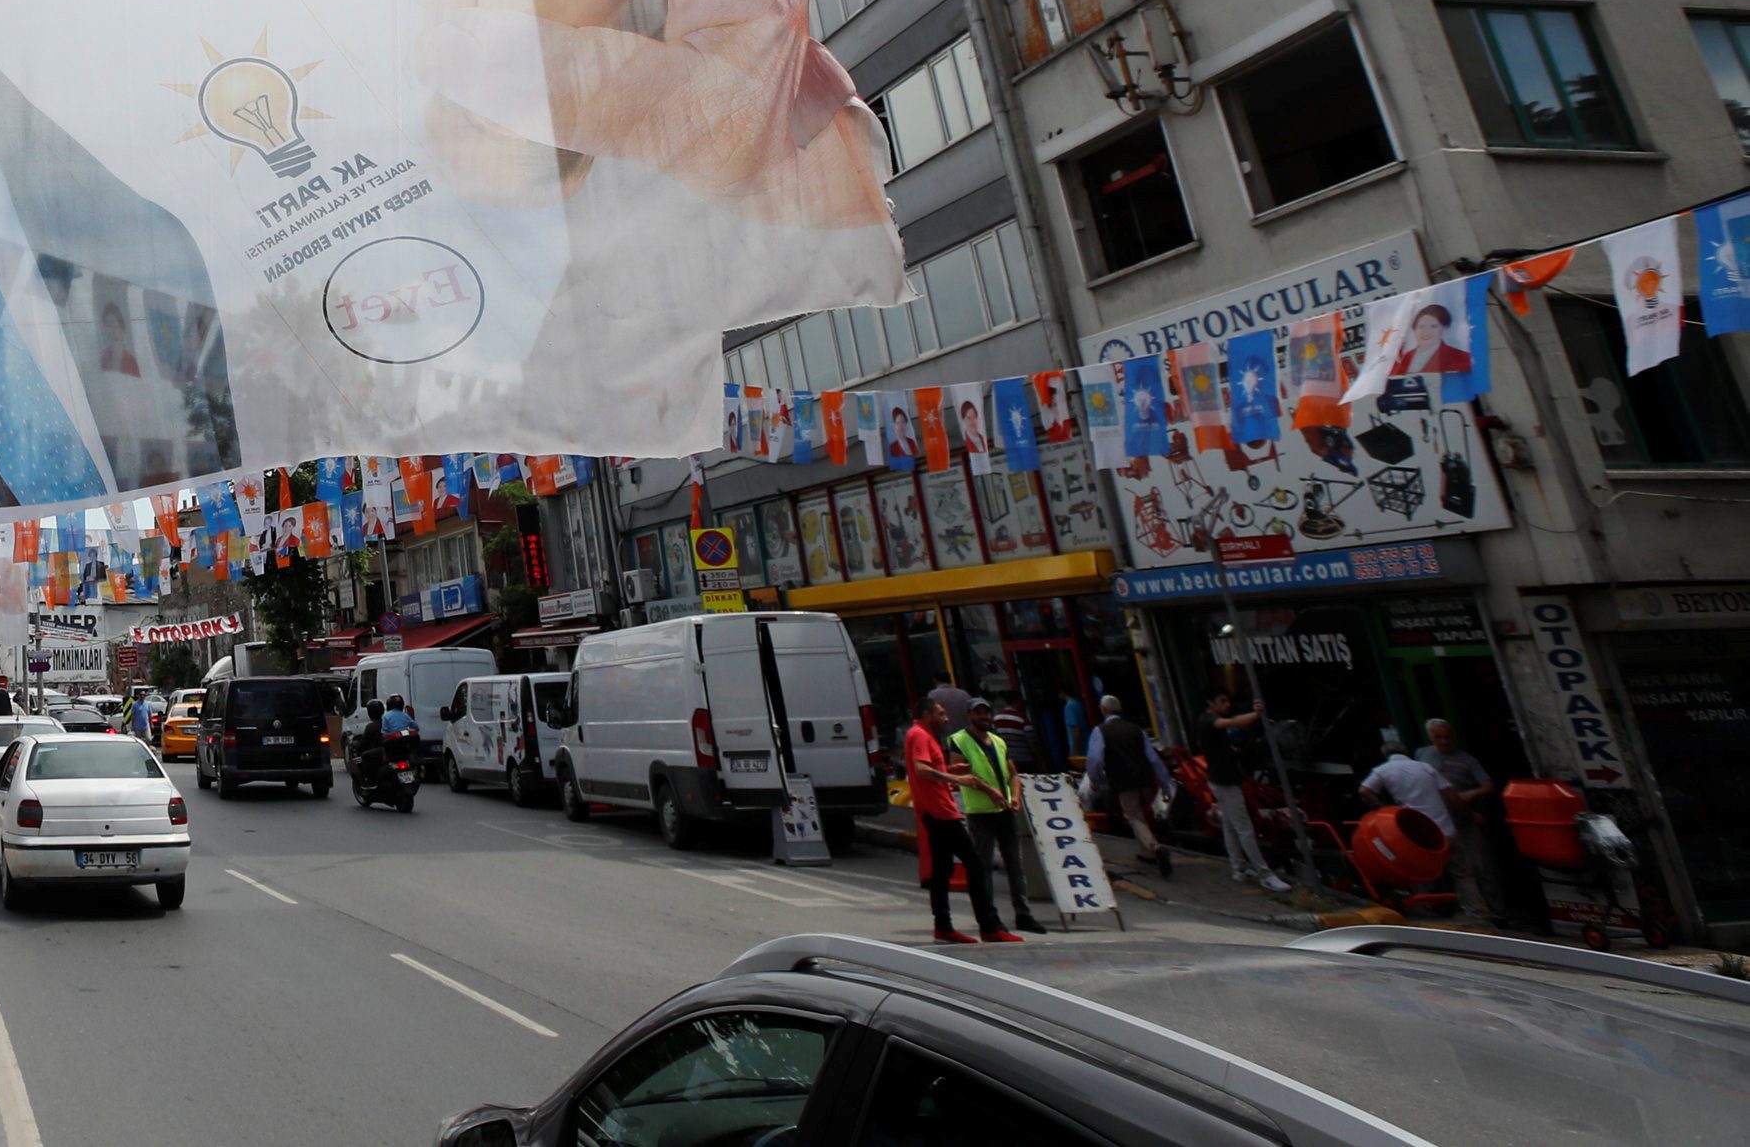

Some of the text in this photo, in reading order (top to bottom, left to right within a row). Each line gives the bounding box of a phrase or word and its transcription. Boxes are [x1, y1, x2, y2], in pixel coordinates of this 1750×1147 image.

[1139, 257, 1392, 354] BETONCULAR
[148, 618, 223, 644] OTOPARK
[1210, 635, 1299, 666] İMAATTAN
[1533, 603, 1618, 762] OTOPARK
[83, 853, 94, 864] 34
